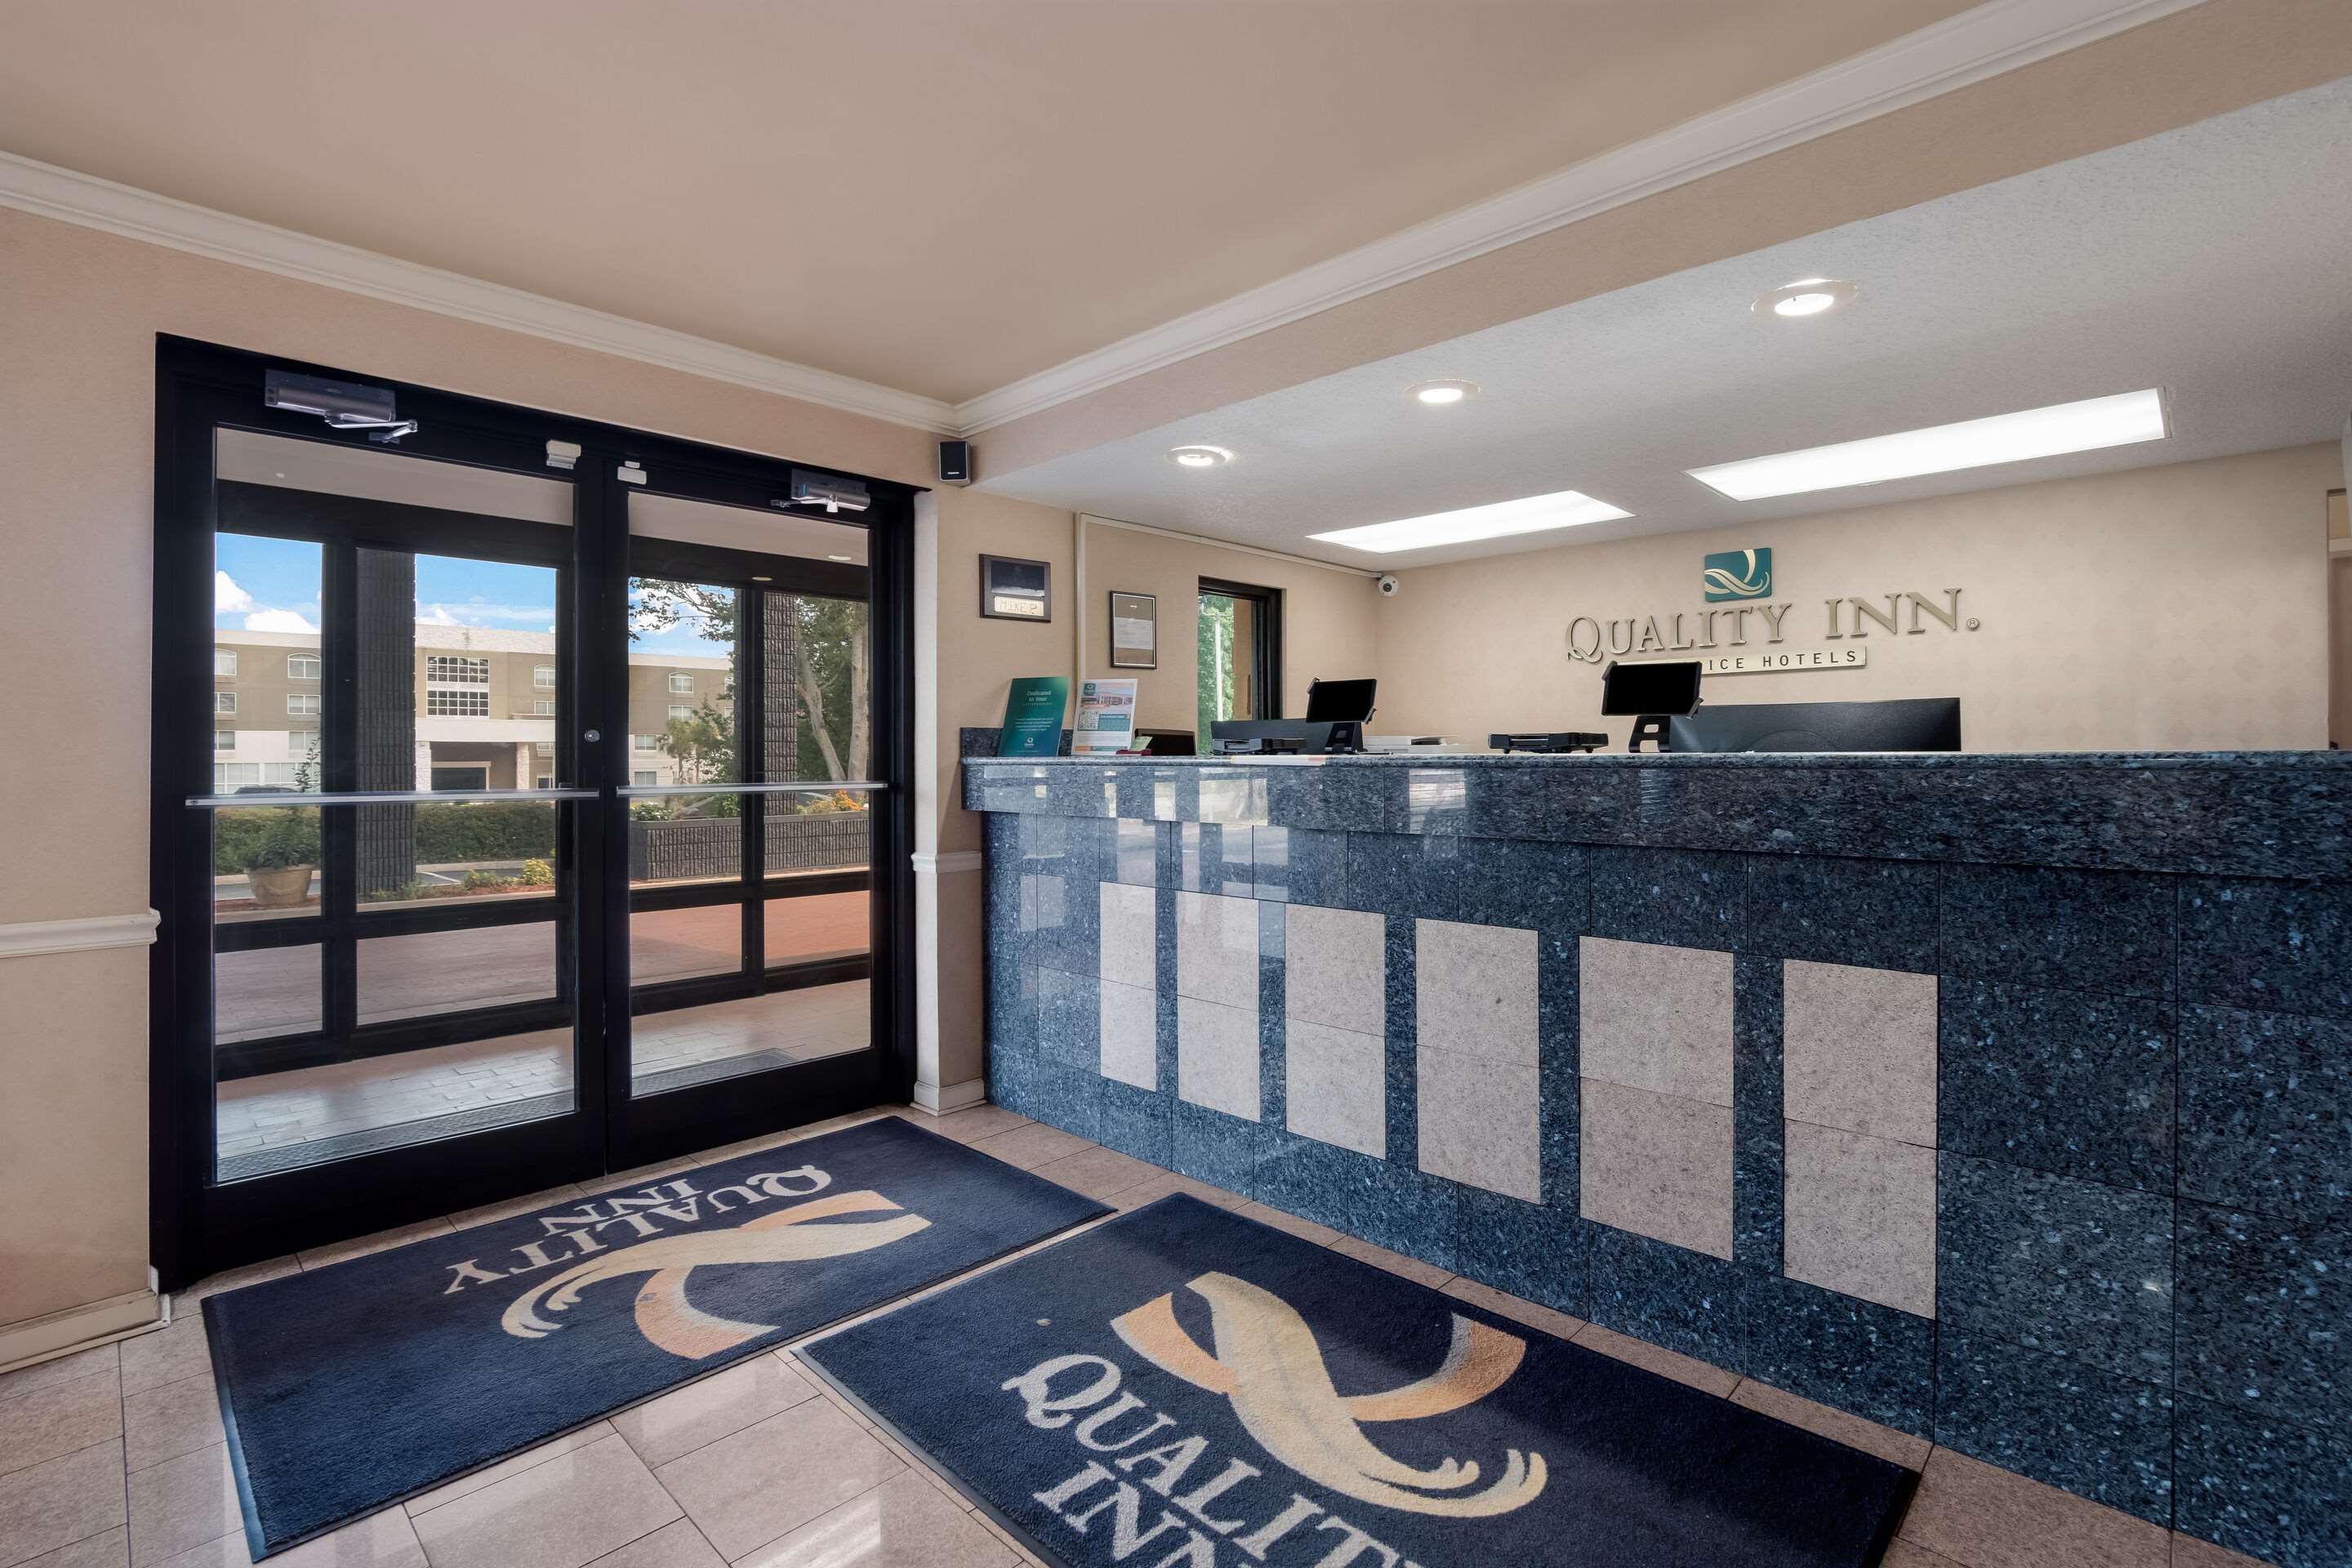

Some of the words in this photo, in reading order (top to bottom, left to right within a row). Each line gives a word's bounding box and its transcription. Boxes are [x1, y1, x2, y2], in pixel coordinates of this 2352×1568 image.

[1566, 603, 1792, 664] QUALITY
[1708, 657, 1745, 670] ICE
[1762, 650, 1856, 668] HOTELS
[443, 1164, 832, 1295] QUALITY
[539, 1178, 704, 1236] INN
[1001, 1353, 1426, 1568] QUALIT
